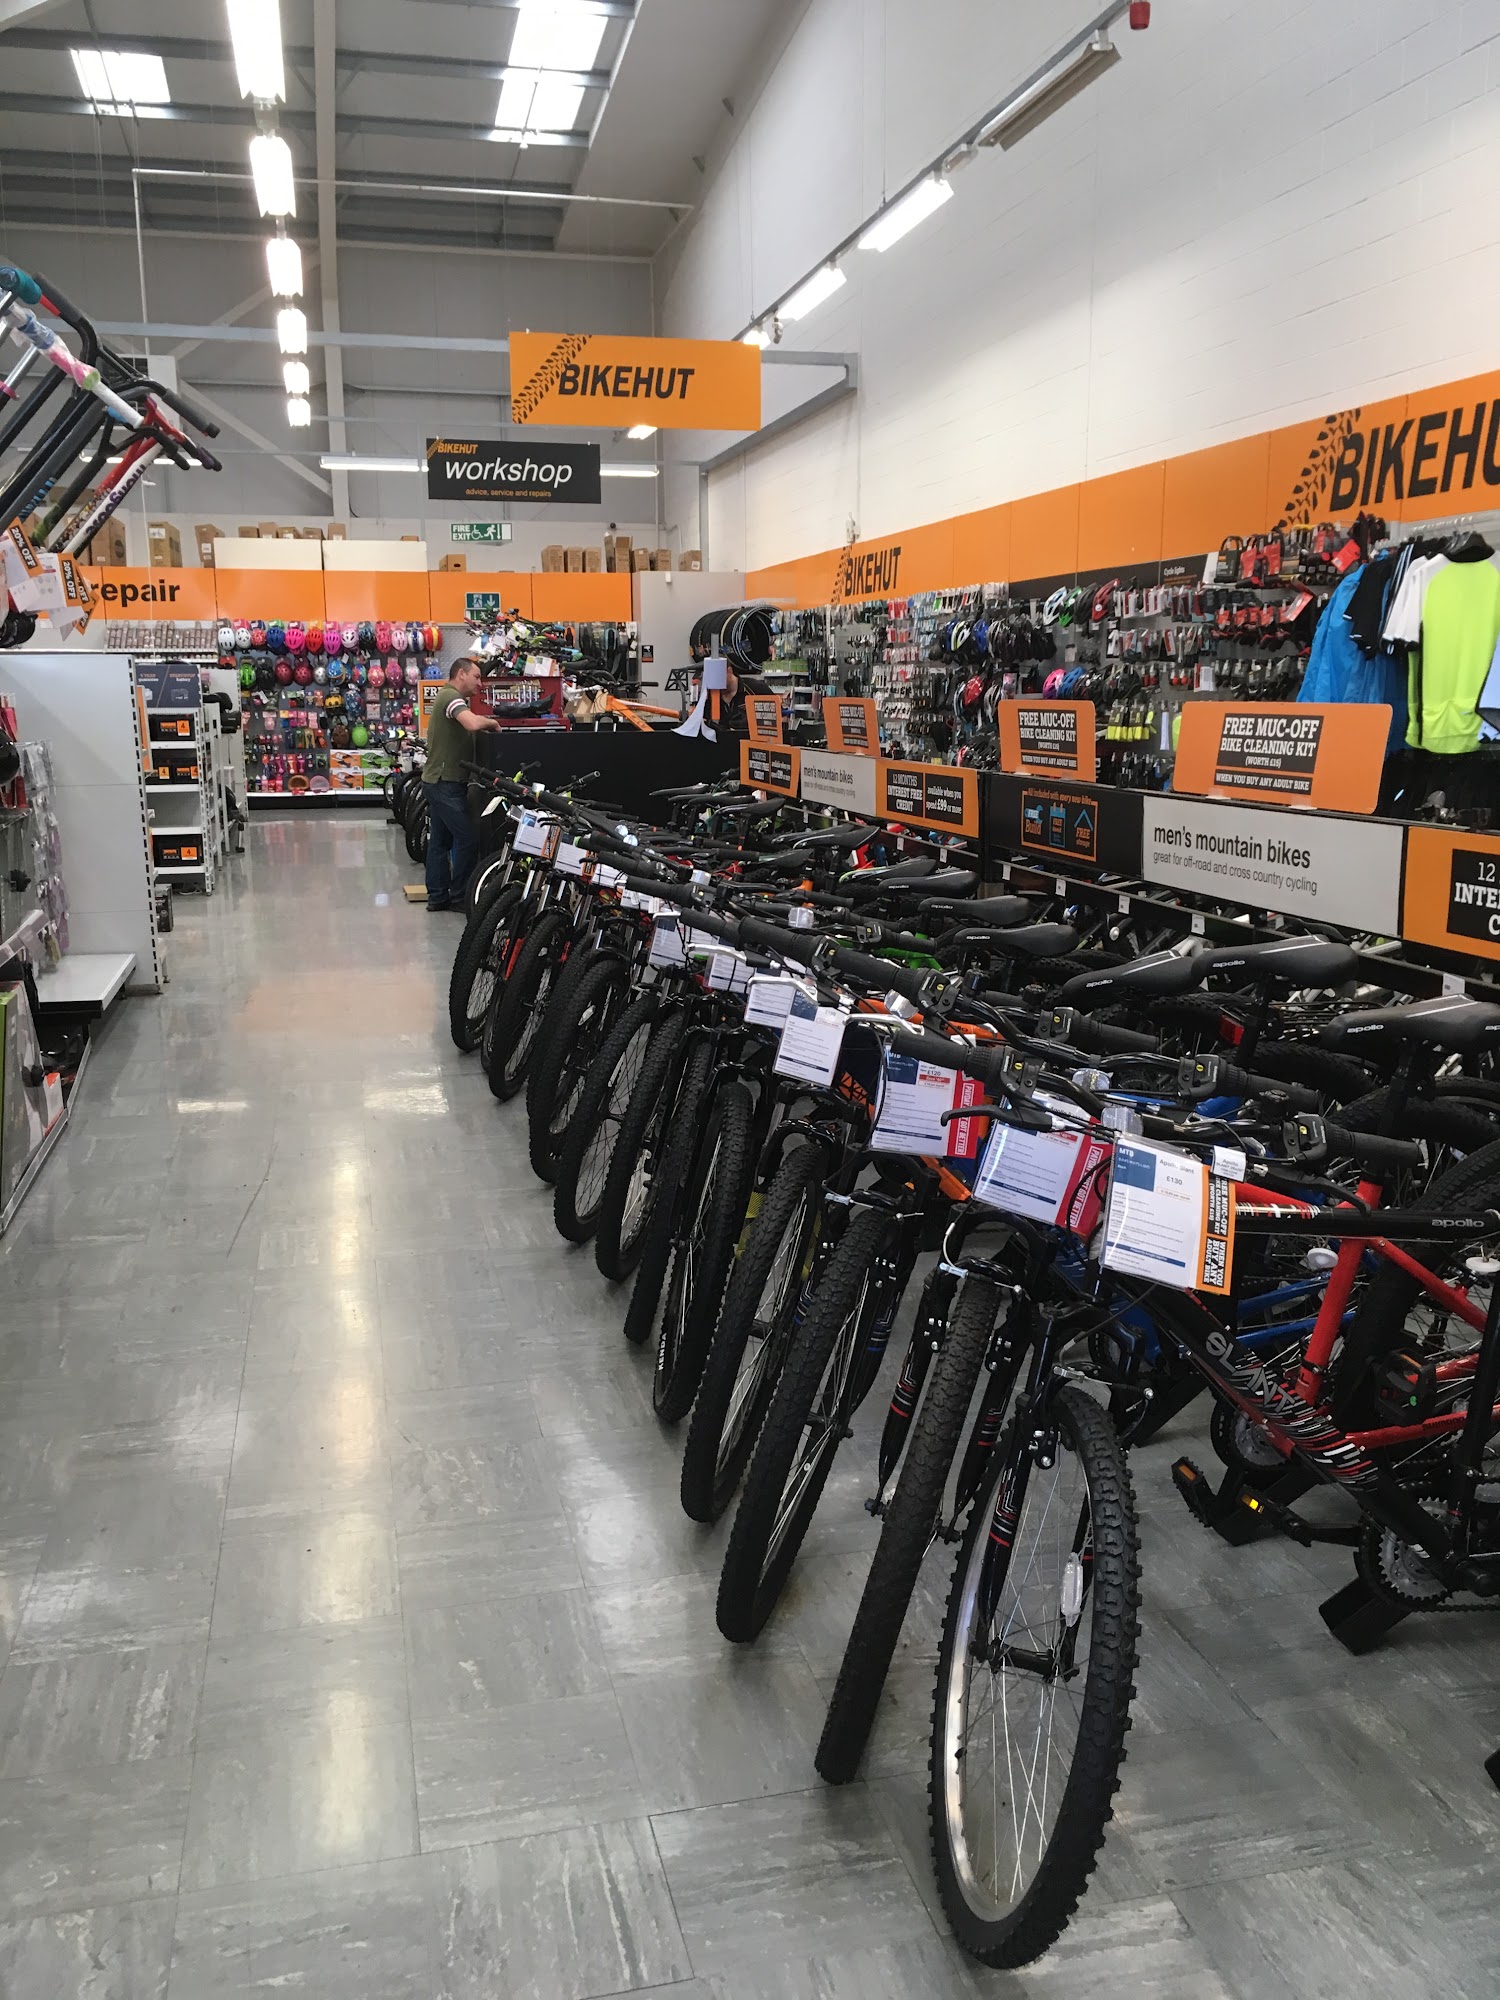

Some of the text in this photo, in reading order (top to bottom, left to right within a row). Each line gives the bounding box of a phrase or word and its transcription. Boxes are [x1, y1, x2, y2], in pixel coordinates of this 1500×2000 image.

[558, 363, 695, 400] BIKEHUT
[437, 442, 478, 455] BIKEHUT
[445, 457, 573, 488] workshop
[465, 487, 552, 498] advice, service and repairs
[452, 525, 471, 534] FIRE
[452, 532, 472, 541] EXIT
[11, 526, 37, 569] 20% OFF
[845, 546, 901, 597] BIKEHUT
[62, 560, 77, 600] 20% OFF
[79, 585, 90, 604] OFF
[1019, 711, 1076, 728] FREE MUC-OFF
[1020, 727, 1077, 742] BIKE CLEANING KIT
[1223, 717, 1320, 739] FREE MUC-OFF
[1220, 737, 1317, 757] BIKE CLEANING KIT
[1245, 755, 1282, 768] (WORTH £15)
[817, 768, 839, 782] mountain
[839, 770, 854, 785] bikes
[893, 774, 918, 787] 12 MONTHS
[1216, 772, 1310, 791] WHEN YOU BUY ANY ADULT BIKE
[887, 785, 923, 801] INTEREST FREE
[928, 786, 962, 801] available when you
[1060, 793, 1071, 804] every
[895, 798, 914, 812] CREDIT
[926, 799, 938, 812] spend
[938, 799, 947, 811] £99
[952, 806, 962, 815] more
[1025, 819, 1042, 835] Build
[1076, 827, 1091, 840] FREE
[1153, 826, 1311, 869] men's mountain bikes
[1153, 850, 1318, 896] great for off-road and cross country cycling
[1477, 862, 1496, 883] 12
[1454, 881, 1500, 911] INTE
[1212, 959, 1246, 969] apollo
[1085, 979, 1114, 988] apollo
[1346, 1023, 1385, 1034] apollo
[959, 1120, 969, 1132] GOT
[956, 1131, 967, 1154] BETTER
[1119, 1147, 1134, 1158] MTB
[1222, 1158, 1239, 1168] Apollo
[1166, 1175, 1183, 1186] £130
[1077, 1186, 1089, 1199] GOT
[1214, 1189, 1222, 1225] CLEANING
[1219, 1202, 1229, 1236] MUC-OFF
[1431, 1217, 1485, 1228] apollo
[1219, 1241, 1227, 1264] WHEN
[1203, 1238, 1213, 1284] ADULT BIKE
[1210, 1240, 1221, 1286] BUY ANY
[657, 1331, 668, 1371] KENDA
[1205, 1331, 1298, 1412] SLANT
